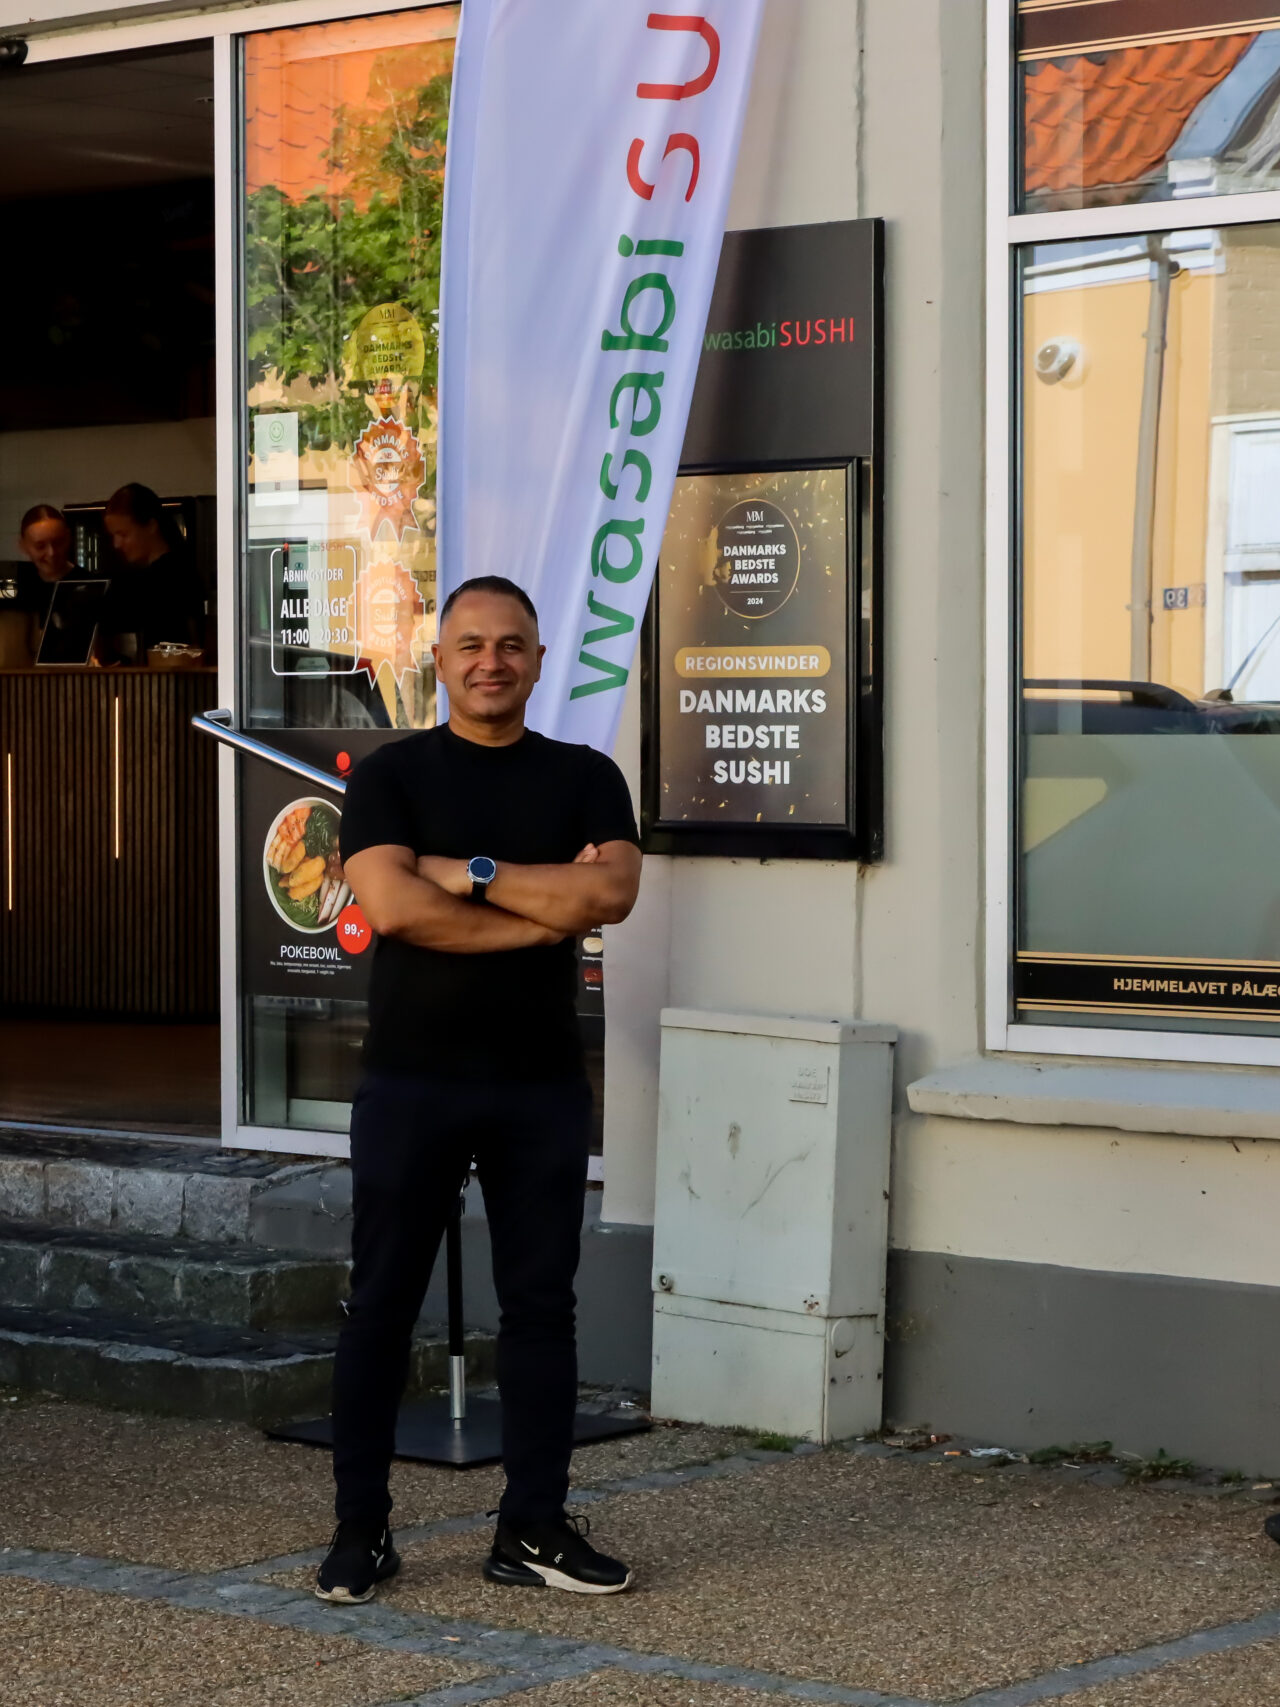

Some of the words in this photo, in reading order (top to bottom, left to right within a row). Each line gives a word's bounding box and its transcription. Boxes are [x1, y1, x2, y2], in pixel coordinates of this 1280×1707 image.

[723, 543, 787, 557] DANMARKS
[734, 558, 776, 571] BEDSTE
[283, 566, 344, 583] ÅBNINGSTIDER
[730, 572, 779, 585] AWARDS
[280, 598, 310, 618] ALLE
[314, 597, 347, 617] DAGE
[747, 597, 763, 605] 2024
[280, 628, 309, 645] 11:00
[320, 627, 349, 644] 20:30
[685, 654, 820, 672] REGIONSVINDER
[679, 688, 827, 714] DANMARKS
[705, 724, 800, 750] BEDSTE
[713, 759, 791, 785] SUSHI
[344, 923, 365, 938] 99,-
[280, 945, 342, 961] POKEBOWL
[1113, 978, 1228, 995] HJEMMELAVET
